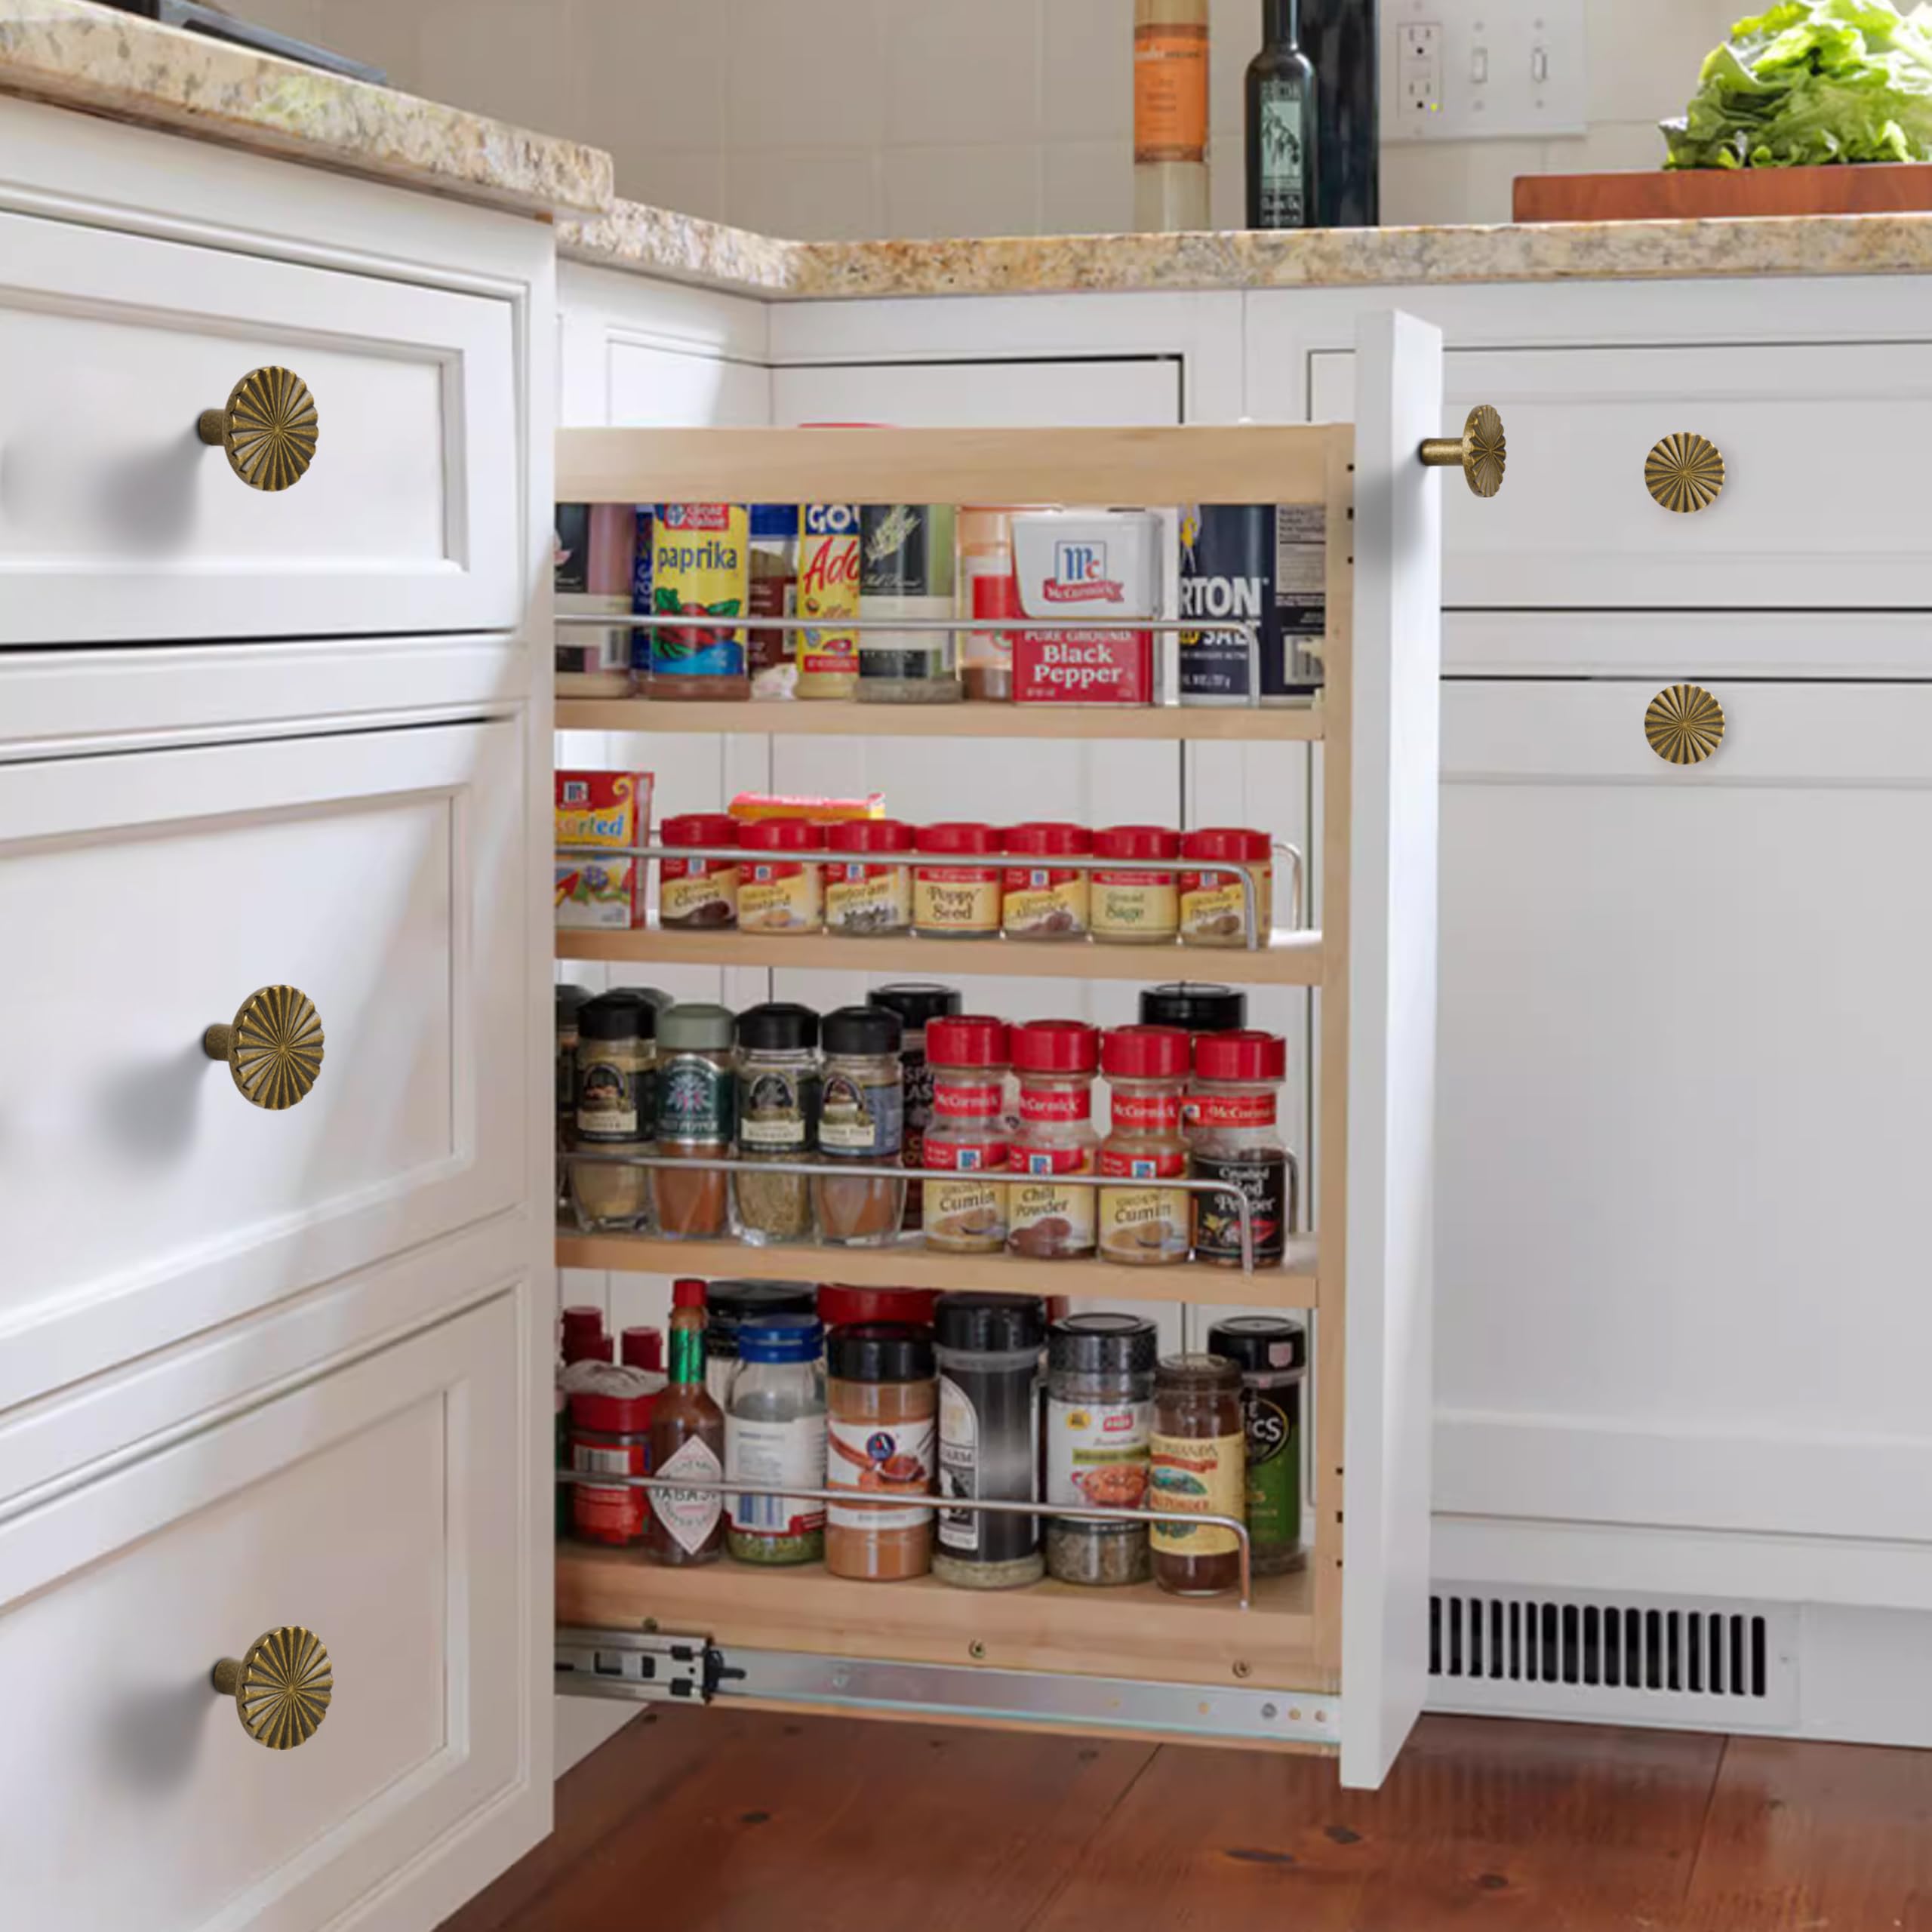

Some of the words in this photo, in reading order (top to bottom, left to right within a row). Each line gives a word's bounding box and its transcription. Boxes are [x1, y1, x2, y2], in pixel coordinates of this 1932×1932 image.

[657, 540, 737, 574] paprika
[1043, 644, 1114, 664] Black
[1033, 665, 1124, 688] Pepper
[926, 886, 980, 904] Poppy
[933, 904, 973, 920] Seed
[940, 1190, 995, 1212] Cumin
[1016, 1199, 1068, 1217] Powder
[1115, 1205, 1171, 1223] Cumin
